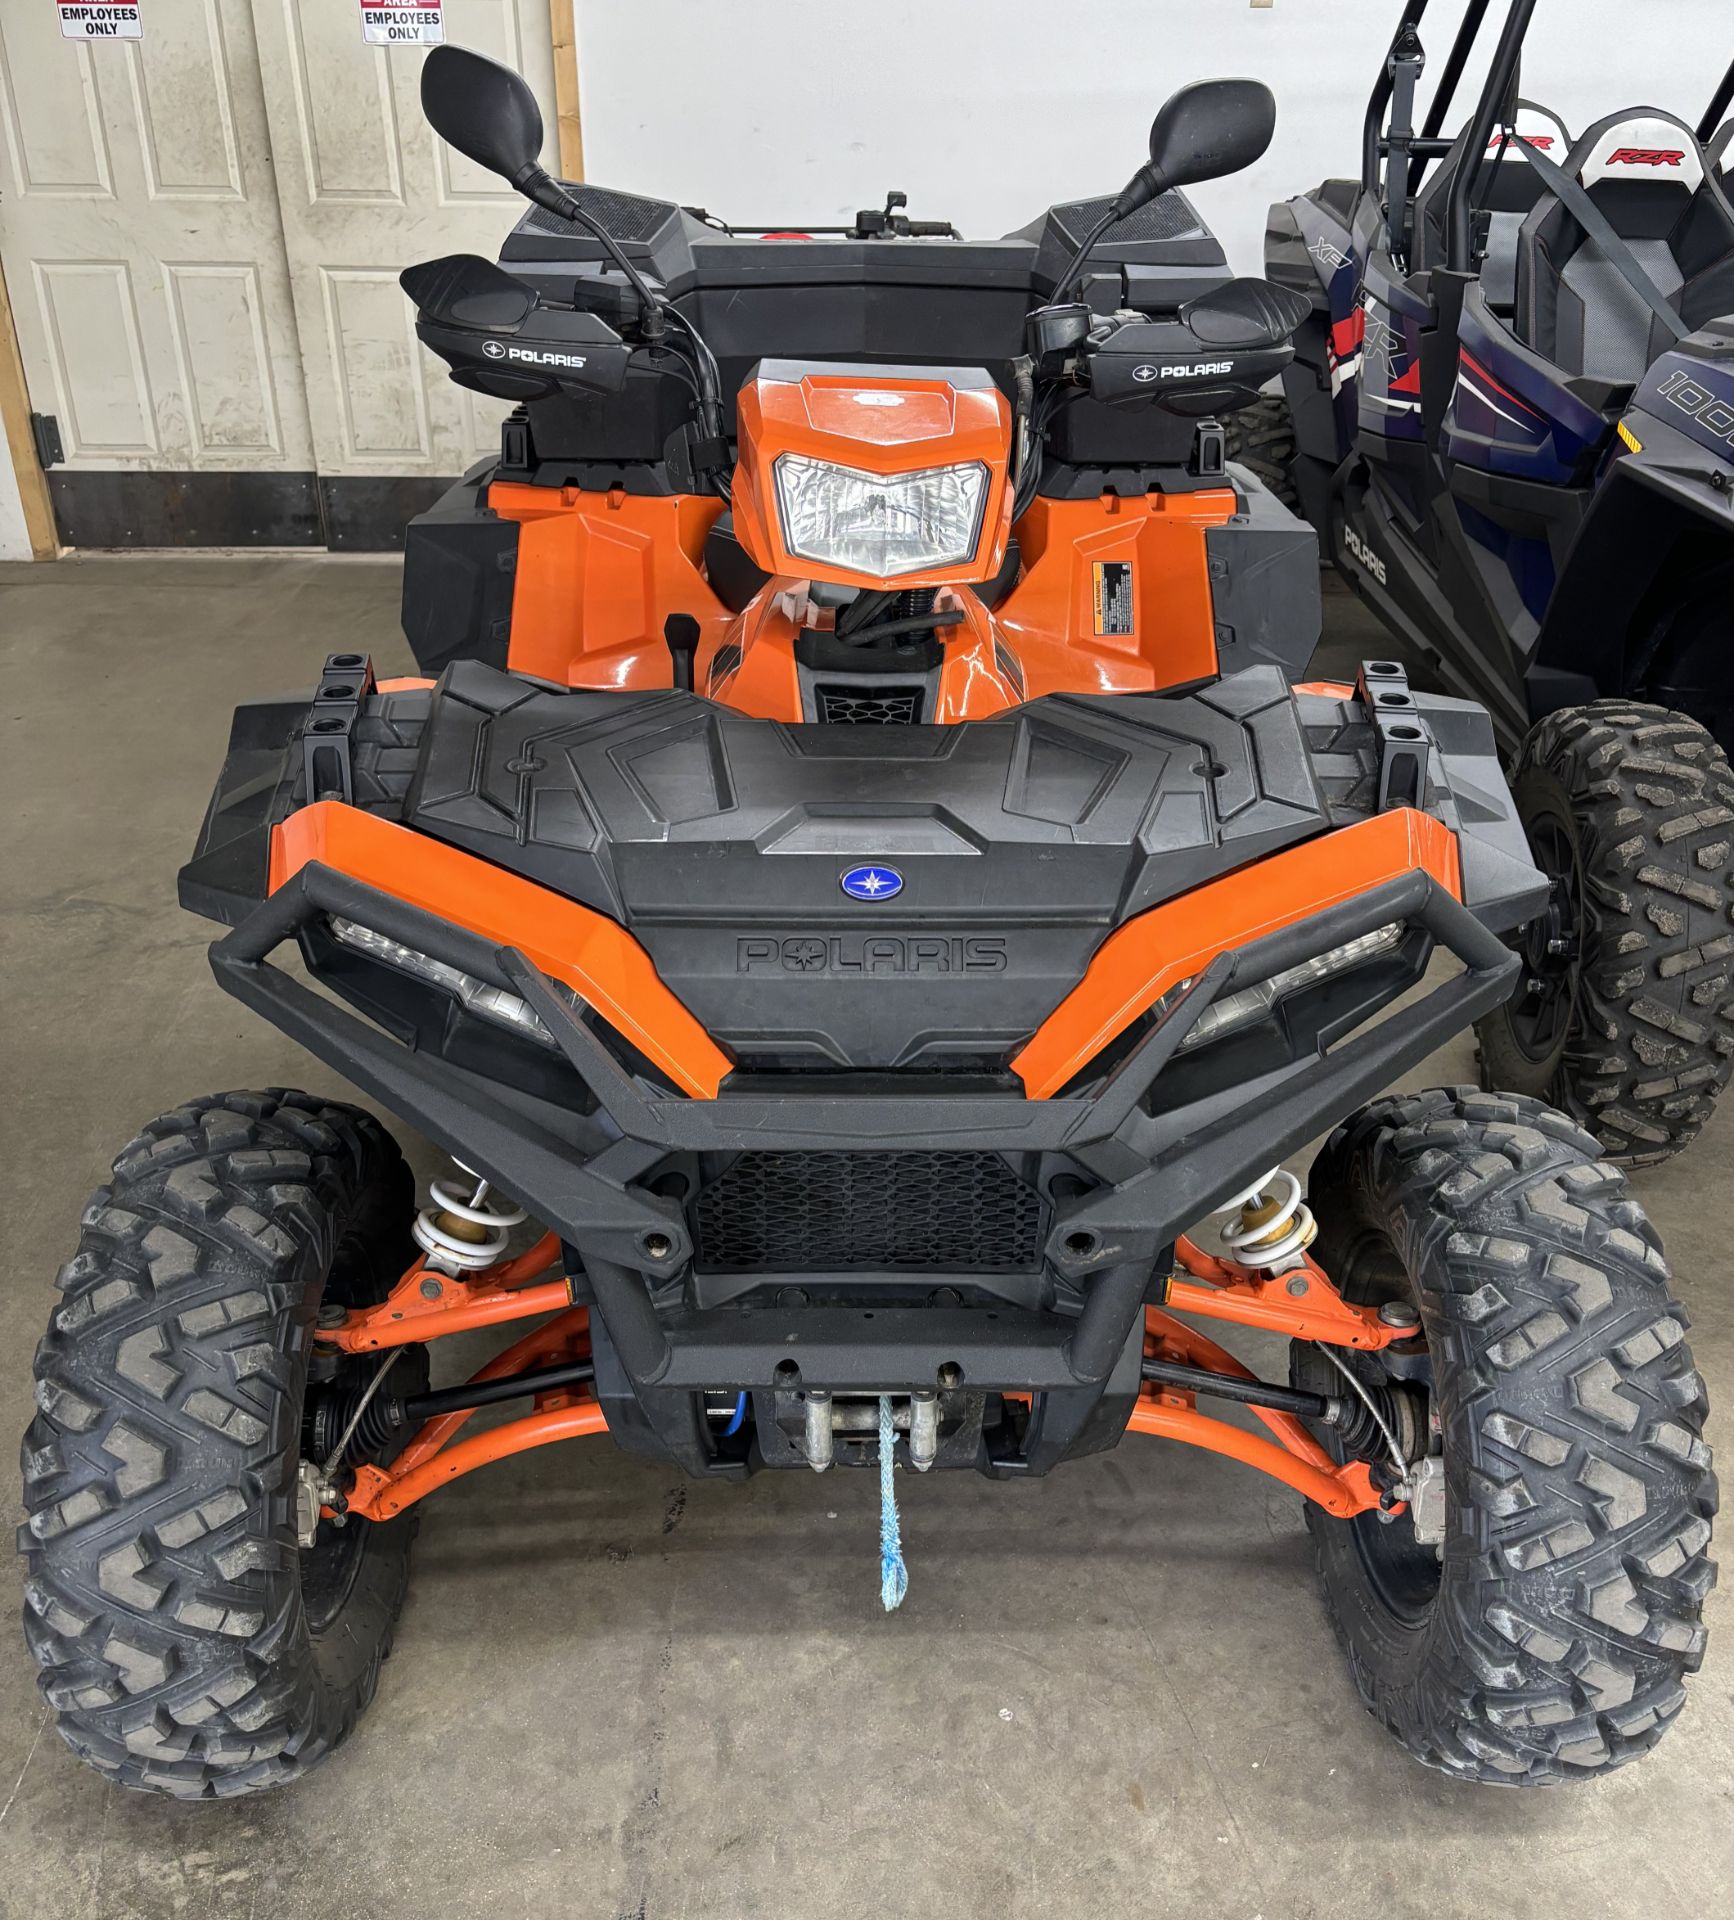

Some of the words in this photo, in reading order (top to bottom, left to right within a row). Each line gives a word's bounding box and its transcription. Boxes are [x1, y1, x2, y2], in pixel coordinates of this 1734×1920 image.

[61, 8, 138, 20] EMPLOYEES
[365, 12, 440, 24] EMPLOYEES
[86, 23, 118, 35] ONLY
[388, 27, 420, 39] ONLY
[1605, 148, 1685, 166] RZR
[508, 347, 587, 368] POLARIS
[1160, 361, 1234, 378] POLARIS
[1657, 370, 1734, 447] 100
[1344, 524, 1387, 585] POLARIS
[736, 937, 1008, 972] POLARIS
